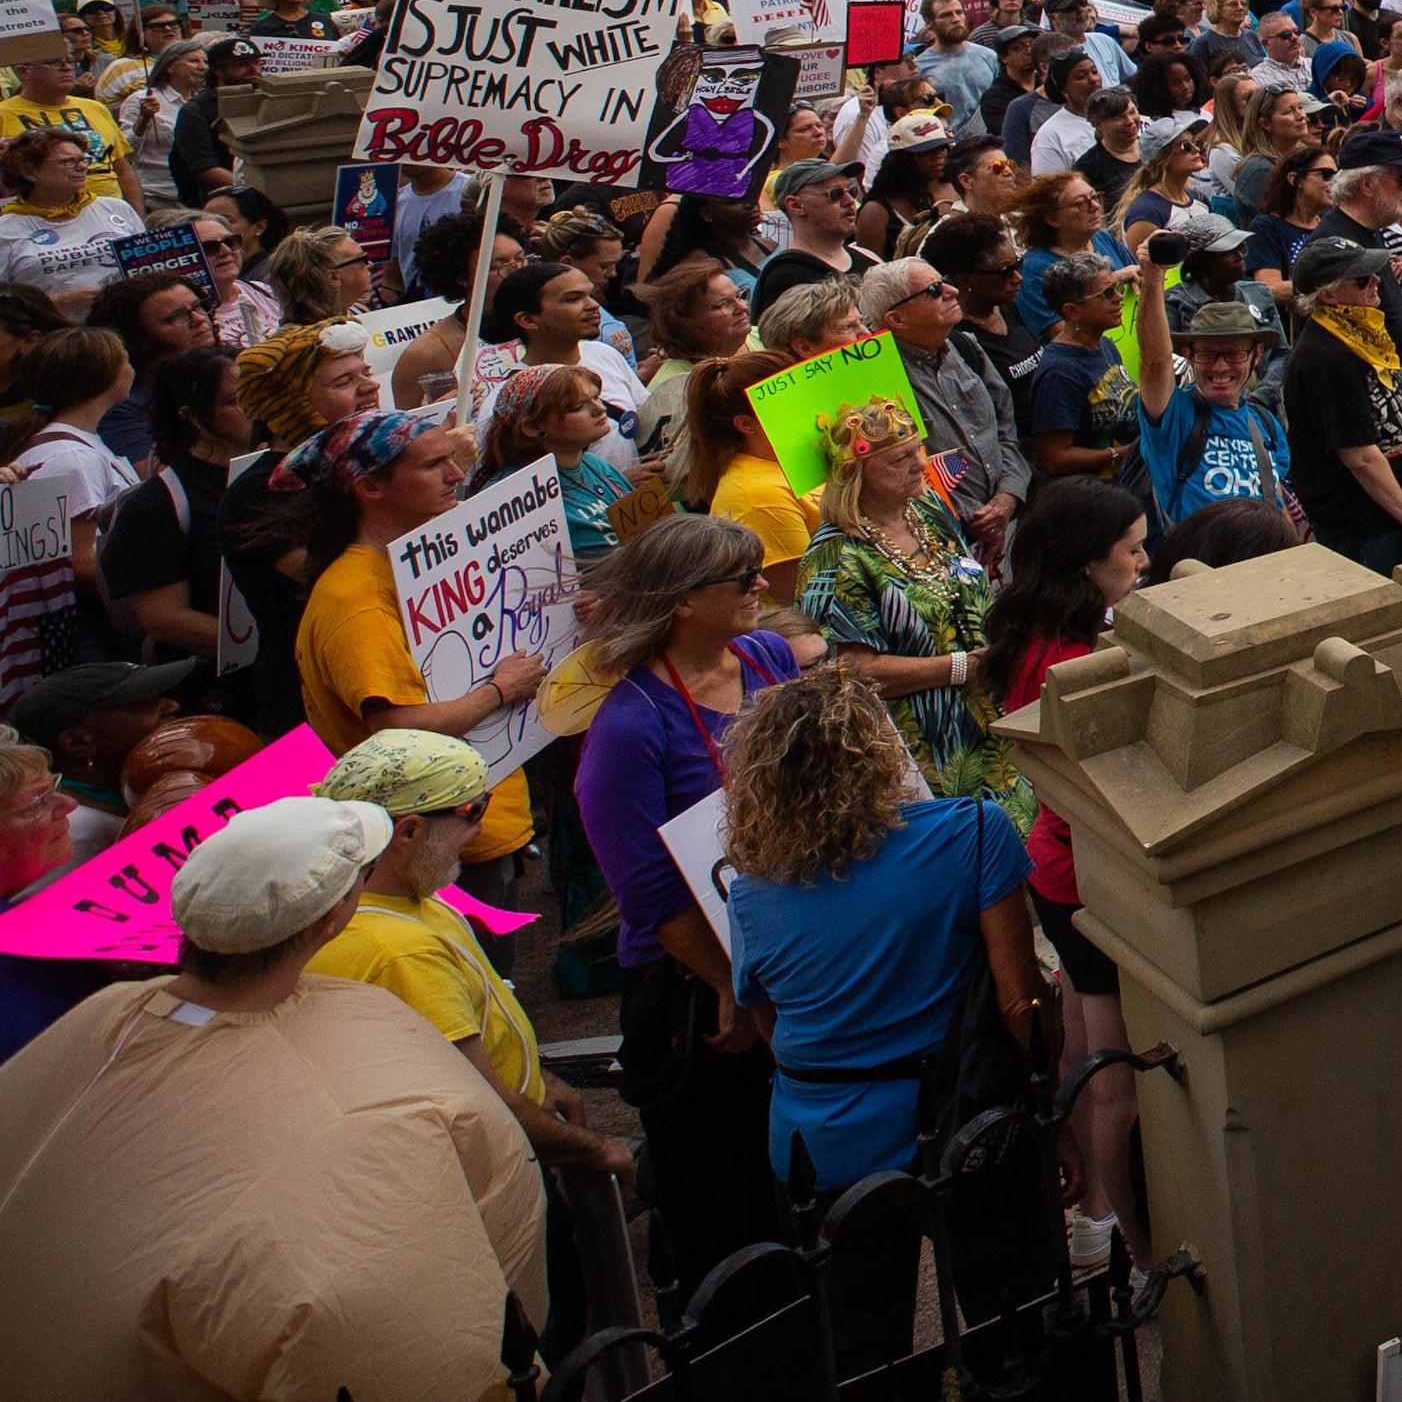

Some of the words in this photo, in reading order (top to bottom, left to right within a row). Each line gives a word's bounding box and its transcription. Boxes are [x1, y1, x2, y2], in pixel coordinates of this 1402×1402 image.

[6, 7, 28, 16] the
[289, 43, 333, 53] KINGS
[436, 4, 559, 69] JUST
[546, 20, 660, 72] WHITE
[375, 56, 584, 118] SUPREMACY
[599, 87, 646, 125] IN
[363, 107, 507, 165] Bible
[512, 115, 643, 186] Drag
[41, 244, 113, 266] PUBLIC
[120, 233, 196, 261] PEOPLE
[133, 237, 151, 246] WE
[153, 230, 176, 242] THE
[127, 252, 201, 279] FORGET
[755, 374, 802, 402] JUST
[804, 352, 834, 380] SAY
[842, 336, 883, 366] NO
[1009, 354, 1038, 380] CHOOSE
[0, 495, 71, 570] INGS!
[400, 531, 459, 580] this
[465, 474, 560, 548] wannabe
[617, 489, 660, 534] NO
[405, 559, 487, 648] KING
[486, 518, 559, 574] deserves
[479, 541, 575, 669] Royal
[471, 612, 495, 641] a
